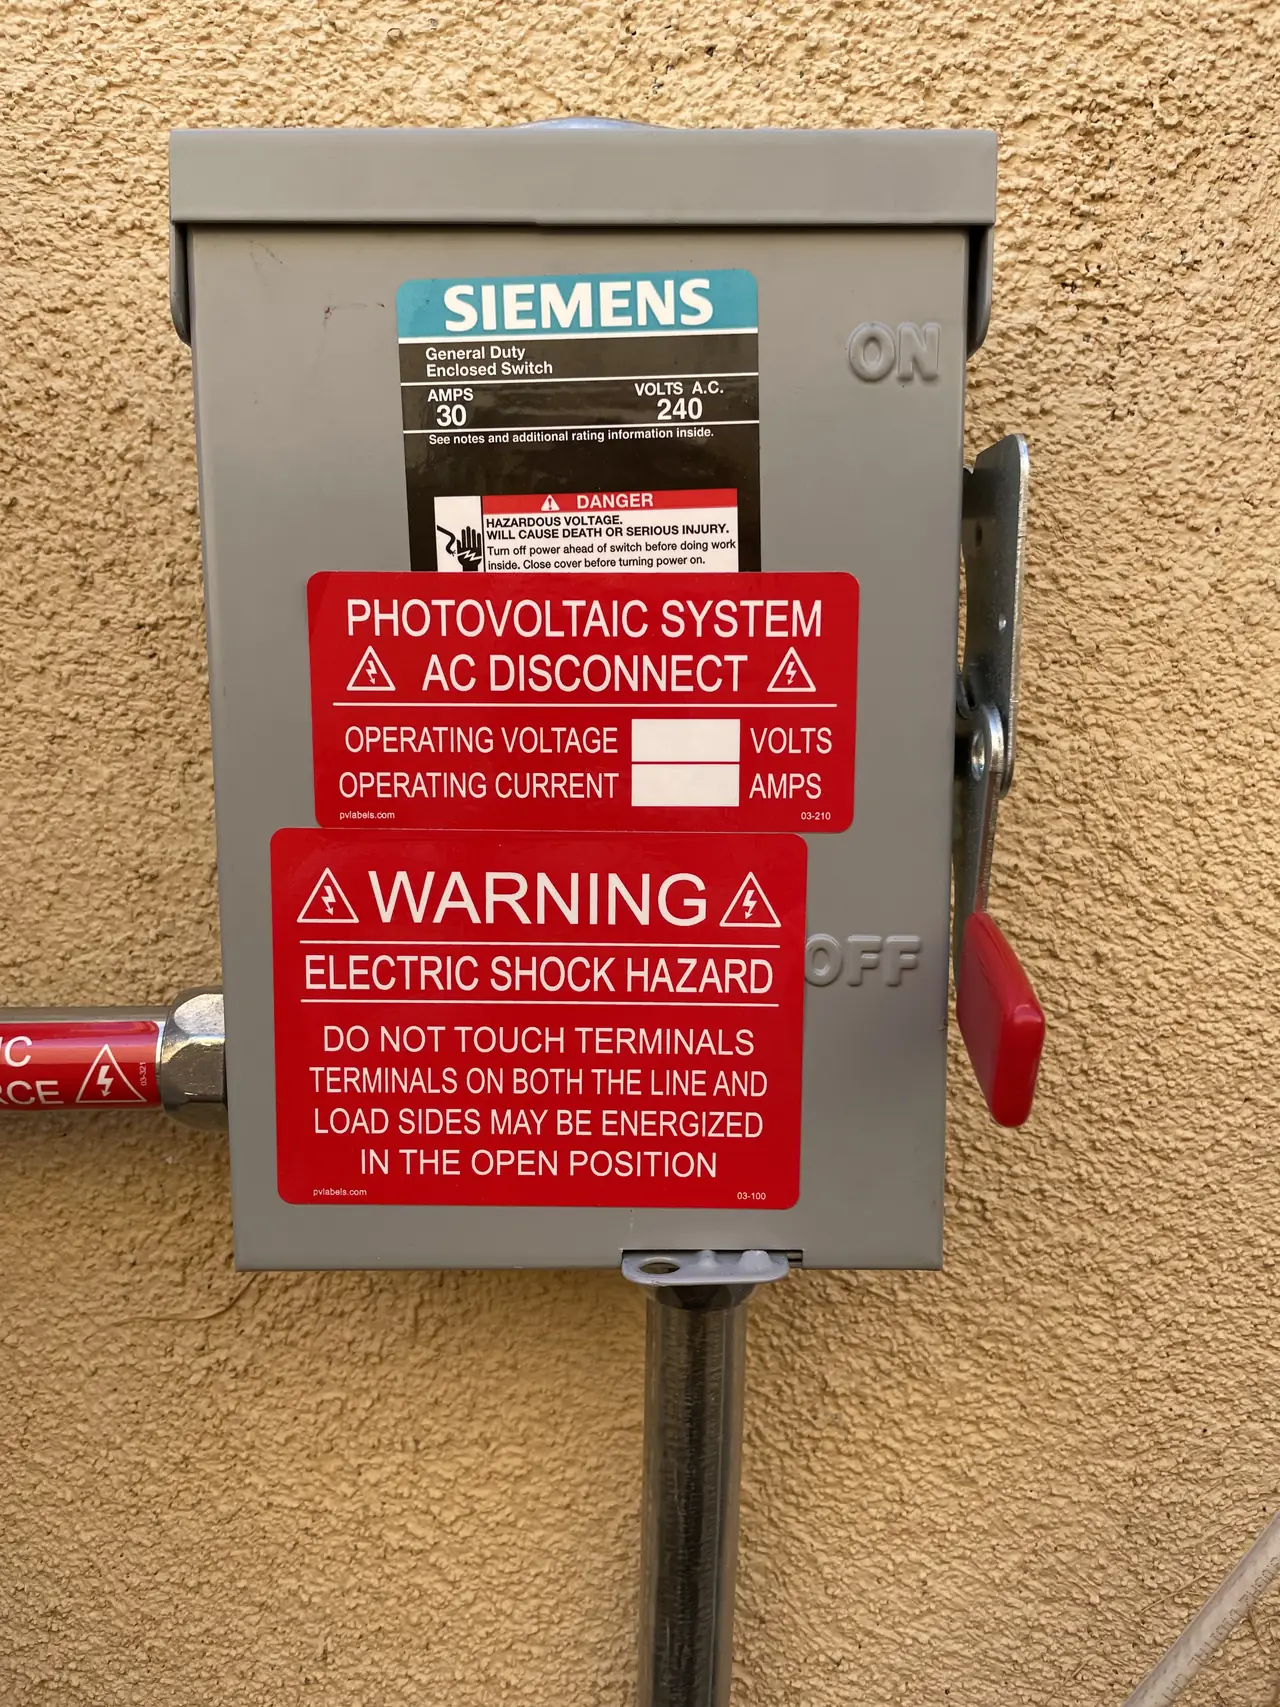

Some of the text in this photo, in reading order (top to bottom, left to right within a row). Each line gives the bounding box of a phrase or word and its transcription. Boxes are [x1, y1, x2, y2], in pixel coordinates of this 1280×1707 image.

[443, 278, 714, 332] SIEMENS
[425, 345, 526, 361] General Duty
[848, 322, 940, 382] ON
[426, 360, 553, 378] Enclosed Switch
[427, 387, 474, 403] AMPS
[634, 380, 724, 397] VOLTS A.C.
[436, 403, 467, 427] 30
[657, 397, 703, 421] 240
[428, 426, 714, 445] See notes and additional rating information inside.
[576, 492, 654, 510] DANGER
[486, 514, 623, 529] HAZARDOUS VOLTAGE.
[486, 523, 730, 540] WILL CAUSE DEATH OR SERIOUS INJURY.
[486, 538, 737, 557] Turn off power ahead of switch before doing work
[487, 556, 706, 571] inside. Close cover before turning power on.
[347, 598, 822, 638] PHOTOVOLTAIC SYSTEM
[421, 653, 748, 693] AC DISCONNECT
[345, 725, 833, 755] OPERATING VOLTAGE VOLTS
[339, 771, 822, 800] OPERATING CURRENT AMPS
[339, 810, 396, 821] pvlabels.com
[800, 811, 831, 821] 03-210
[367, 870, 707, 927] WARNING
[804, 933, 922, 988] OFF
[305, 954, 773, 994] ELECTRIC SHOCK HAZARD
[0, 1035, 33, 1068] C
[323, 1025, 755, 1056] DO NOT TOUCH TERMINALS
[139, 1061, 147, 1087] 03-321
[308, 1066, 768, 1097] TERMINALS ON BOTH THE LINE AND
[314, 1107, 763, 1138] LOAD SIDES MAY BE ENERGIZED
[361, 1148, 717, 1178] IN THE OPEN POSITION
[313, 1187, 367, 1197] pvlabels.com
[736, 1191, 767, 1201] 03-100
